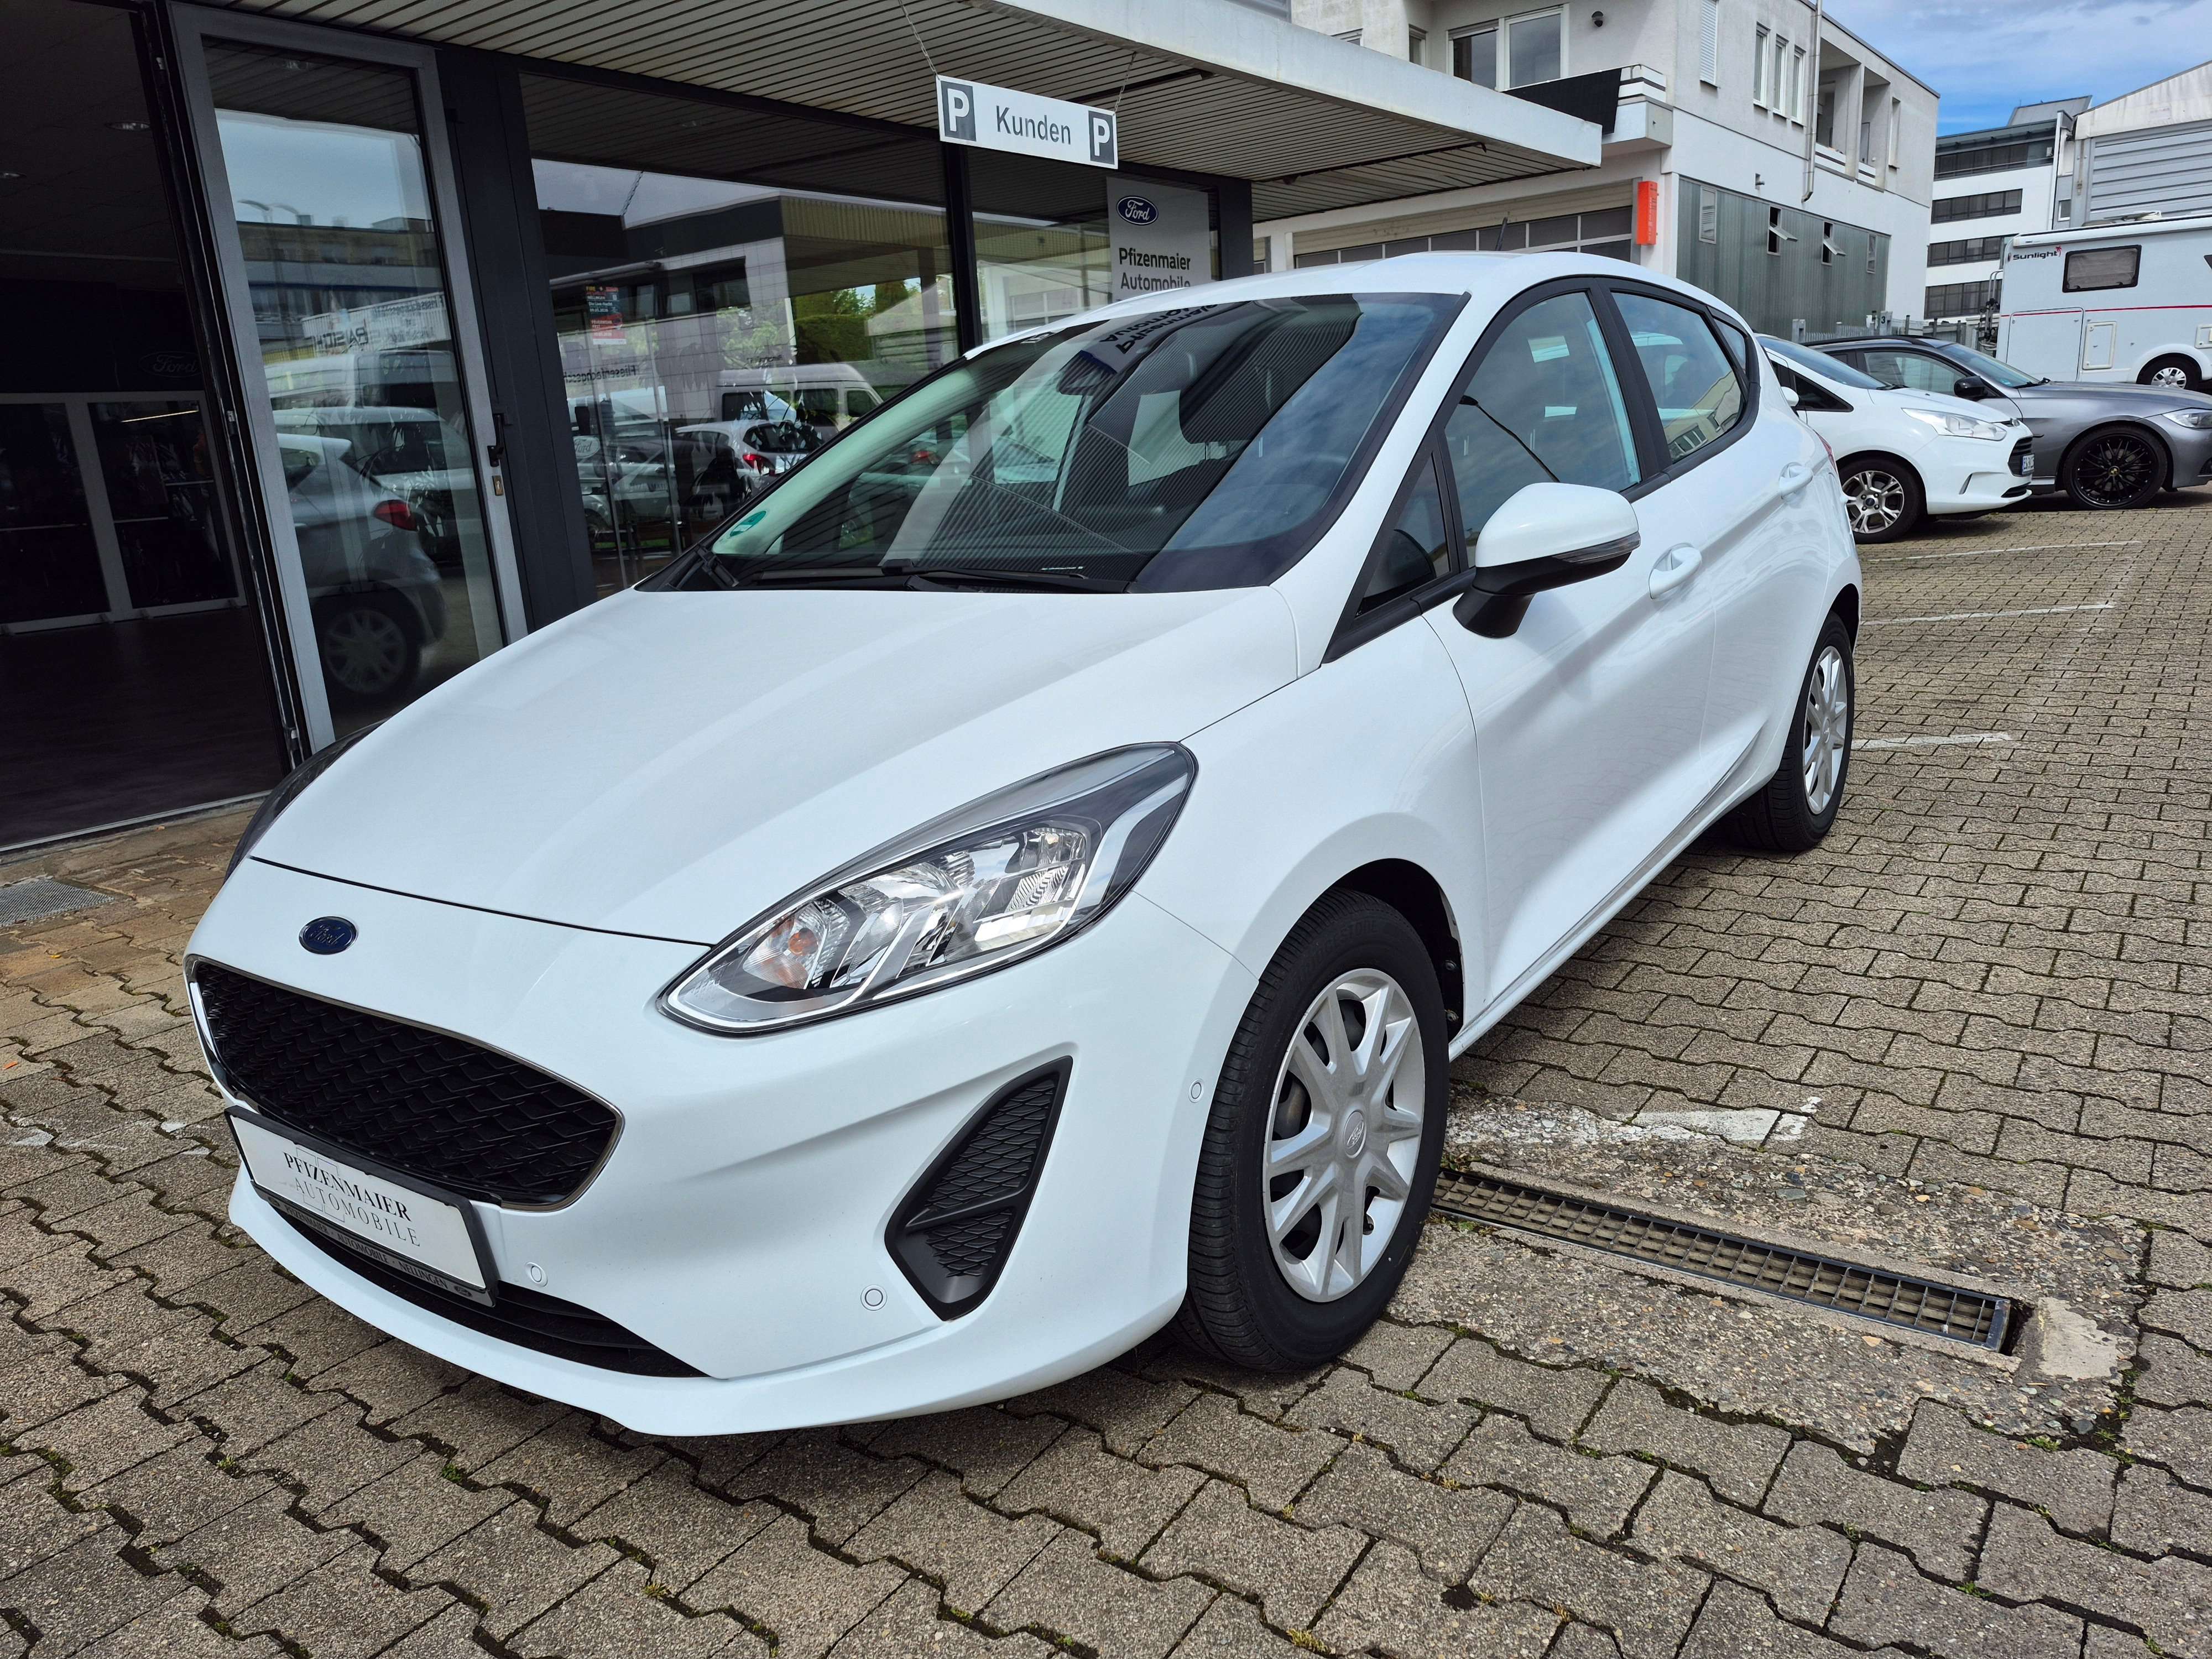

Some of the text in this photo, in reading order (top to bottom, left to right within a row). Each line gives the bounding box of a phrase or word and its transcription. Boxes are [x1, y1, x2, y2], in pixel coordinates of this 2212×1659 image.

[947, 88, 1110, 156] P Kunden P
[1125, 200, 1150, 221] Ford
[1119, 247, 1191, 270] Pfizenmaier
[2013, 251, 2058, 260] Sunlight
[1881, 316, 1886, 324] 3
[153, 354, 197, 373] Ford
[310, 924, 345, 946] Ford
[283, 1152, 412, 1222] PFIZENMAIER
[295, 1177, 420, 1247] AUTOMOBILE
[337, 1233, 390, 1264] AUTOMOBILE
[398, 1260, 448, 1290] NELLINGEN
